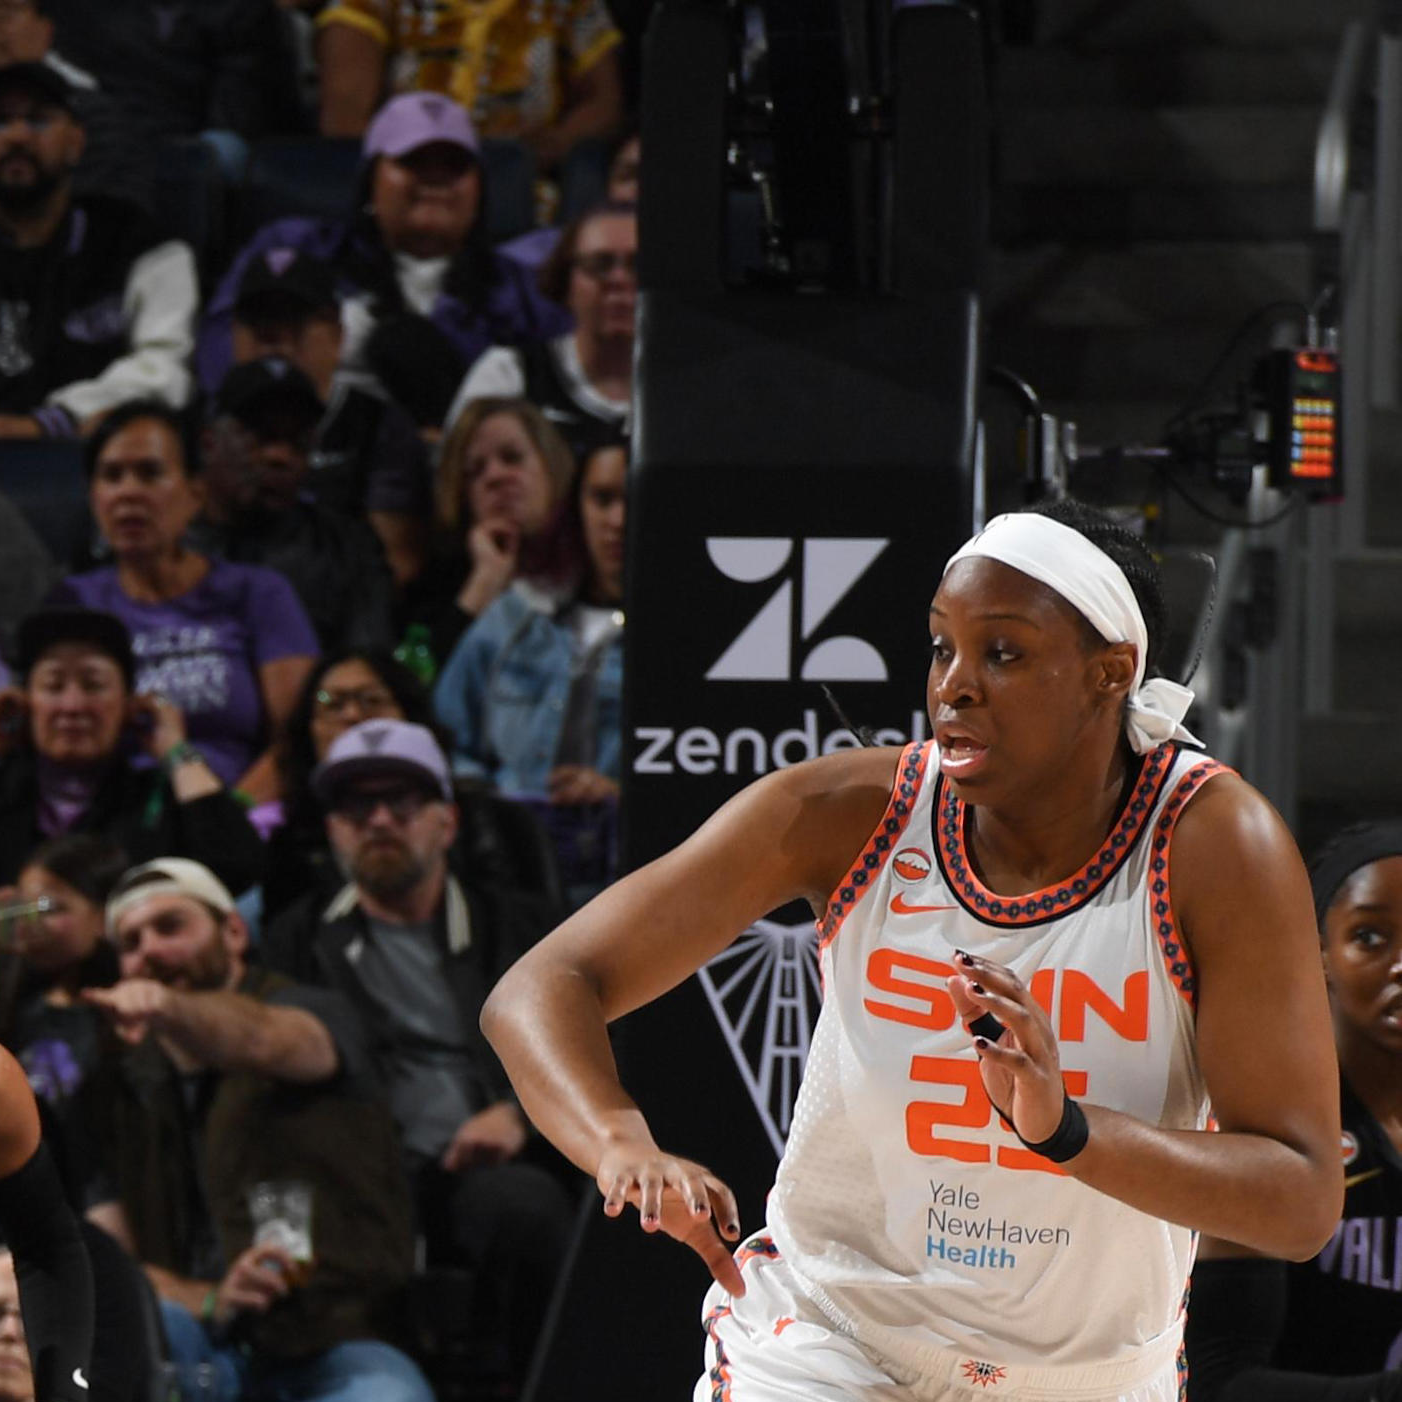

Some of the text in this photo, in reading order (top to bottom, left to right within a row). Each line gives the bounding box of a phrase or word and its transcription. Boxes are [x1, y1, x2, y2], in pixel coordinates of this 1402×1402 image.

[633, 709, 926, 775] zend
[928, 1179, 981, 1210] Yale
[928, 1207, 1071, 1247] NewHaven
[926, 1235, 1017, 1269] Health
